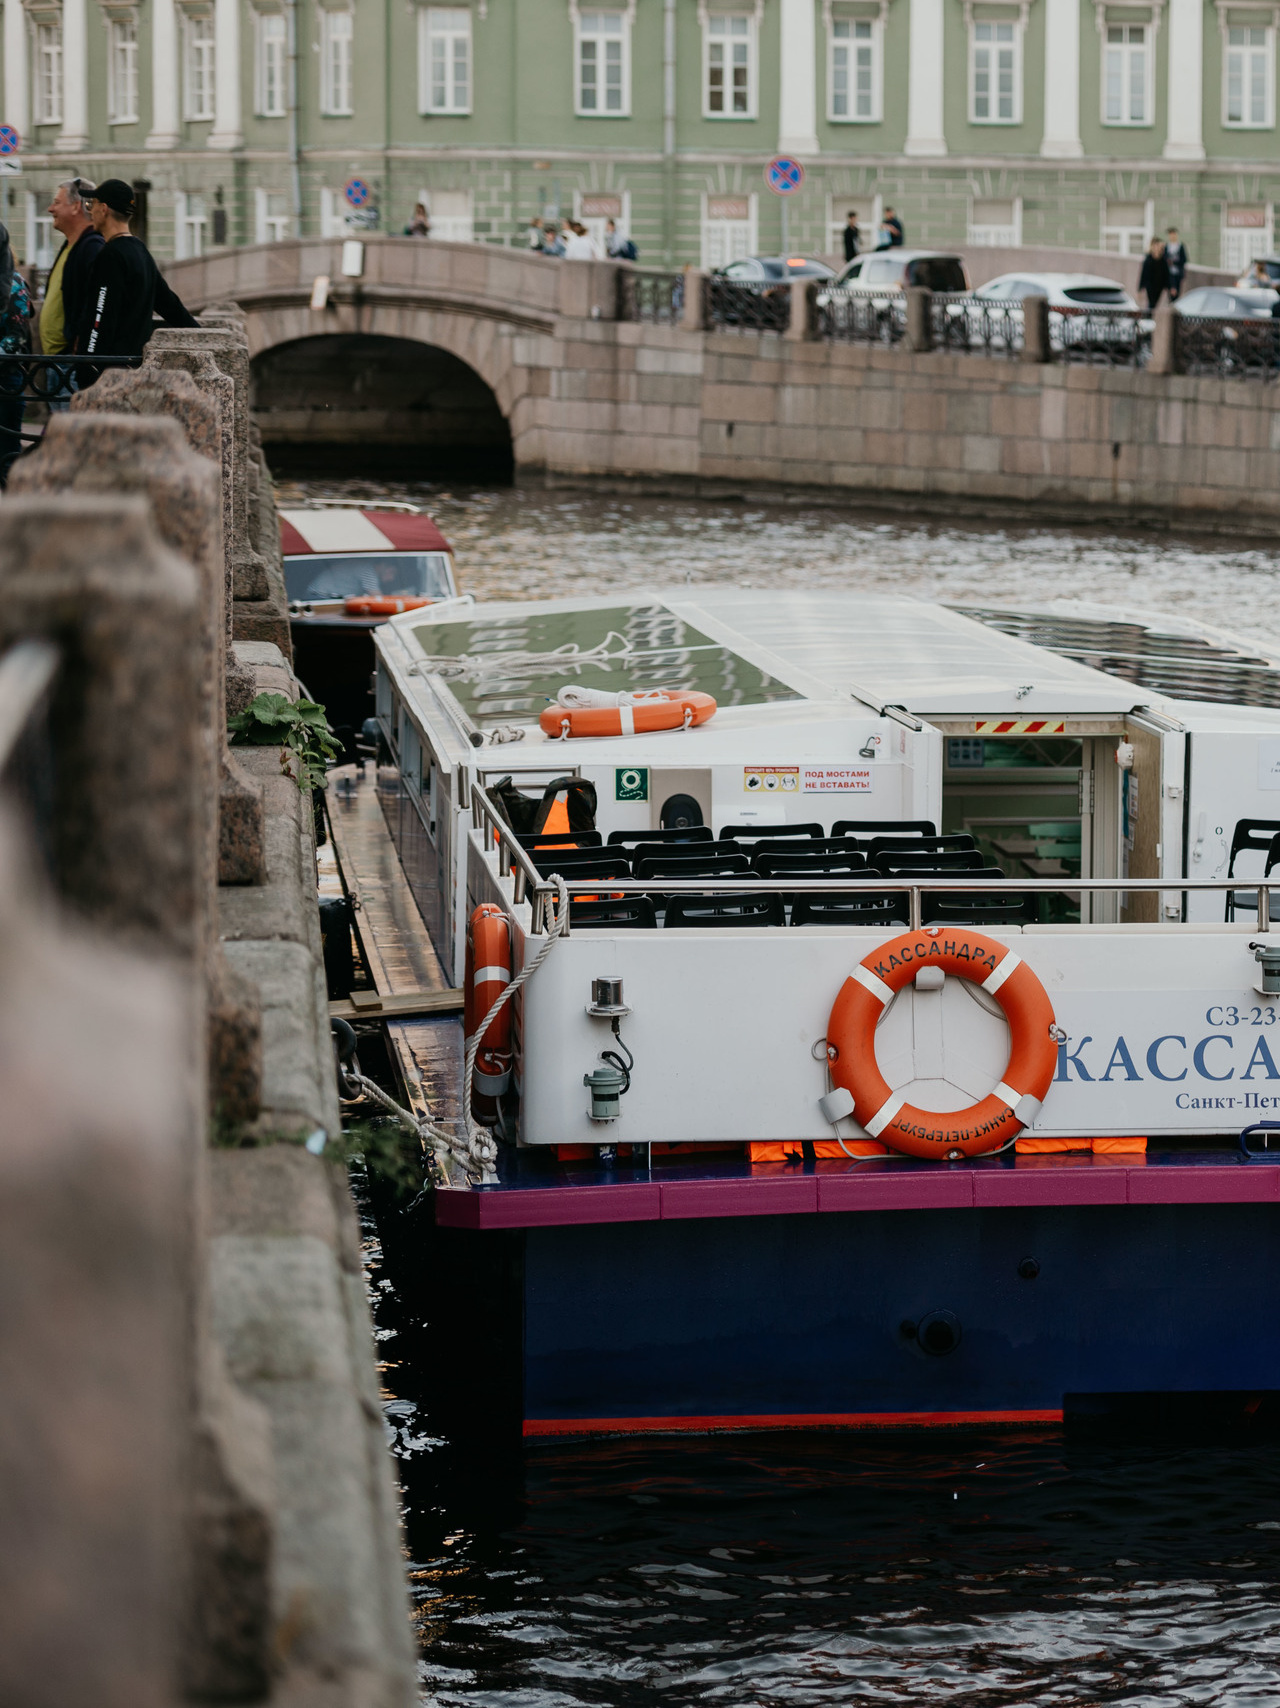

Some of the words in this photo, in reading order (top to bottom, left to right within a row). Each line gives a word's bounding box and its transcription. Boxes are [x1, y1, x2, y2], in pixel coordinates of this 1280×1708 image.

[96, 286, 107, 313] TOMMY
[87, 329, 99, 353] JEANS
[805, 771, 824, 779] ПОД
[873, 940, 998, 979] КАССАНДРА
[891, 1107, 1016, 1143] САНКТ-ПЕТЕРБУРГ
